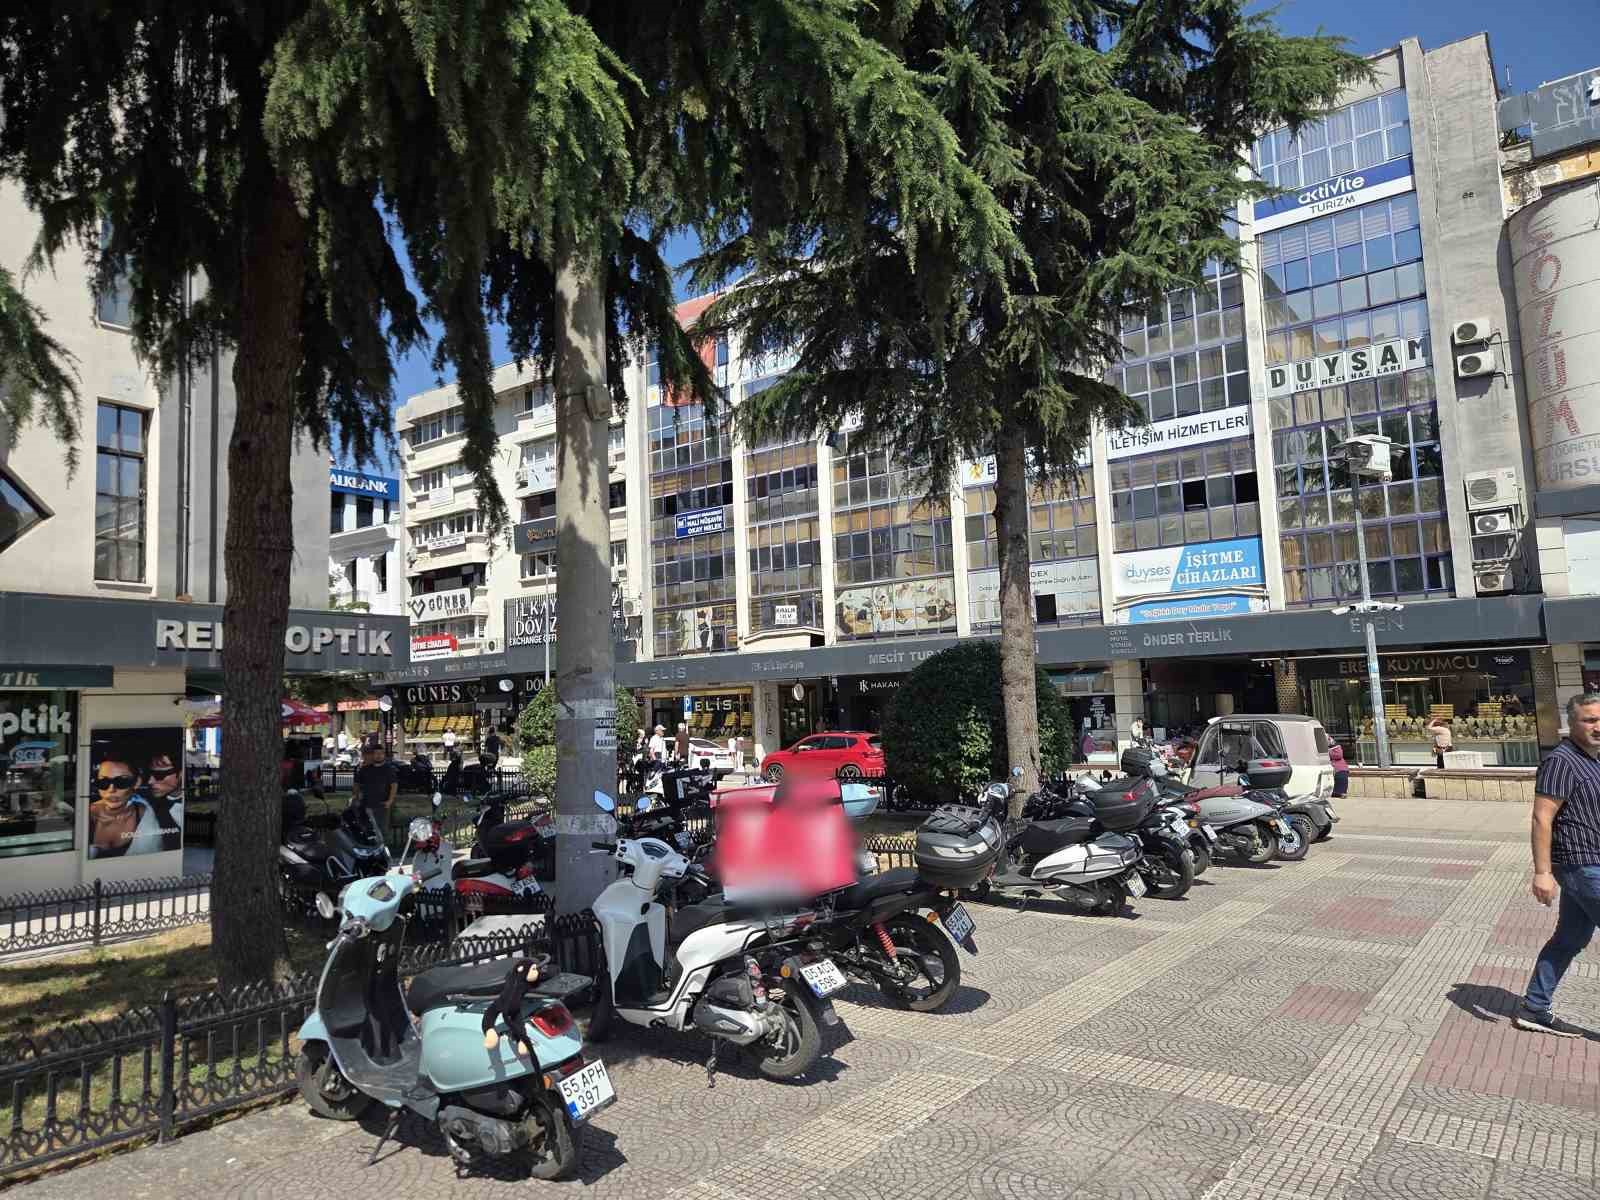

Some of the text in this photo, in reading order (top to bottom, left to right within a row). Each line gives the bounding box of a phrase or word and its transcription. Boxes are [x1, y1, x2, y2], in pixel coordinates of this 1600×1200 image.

[1298, 175, 1365, 205] activite
[1270, 337, 1427, 389] DUYSAM
[1111, 411, 1250, 451] İLETİŞİM HİZMETLERİ
[1185, 549, 1245, 568] İŞİTME
[1176, 565, 1257, 585] CİHAZLARI
[514, 615, 557, 637] DÖVZ
[284, 623, 393, 656] OPTİK
[509, 633, 543, 647] EXCHANGE
[1387, 655, 1480, 671] KUYUMCU
[694, 697, 732, 712] ELİS
[561, 1063, 606, 1097] 55 APH
[577, 1086, 601, 1110] 397
